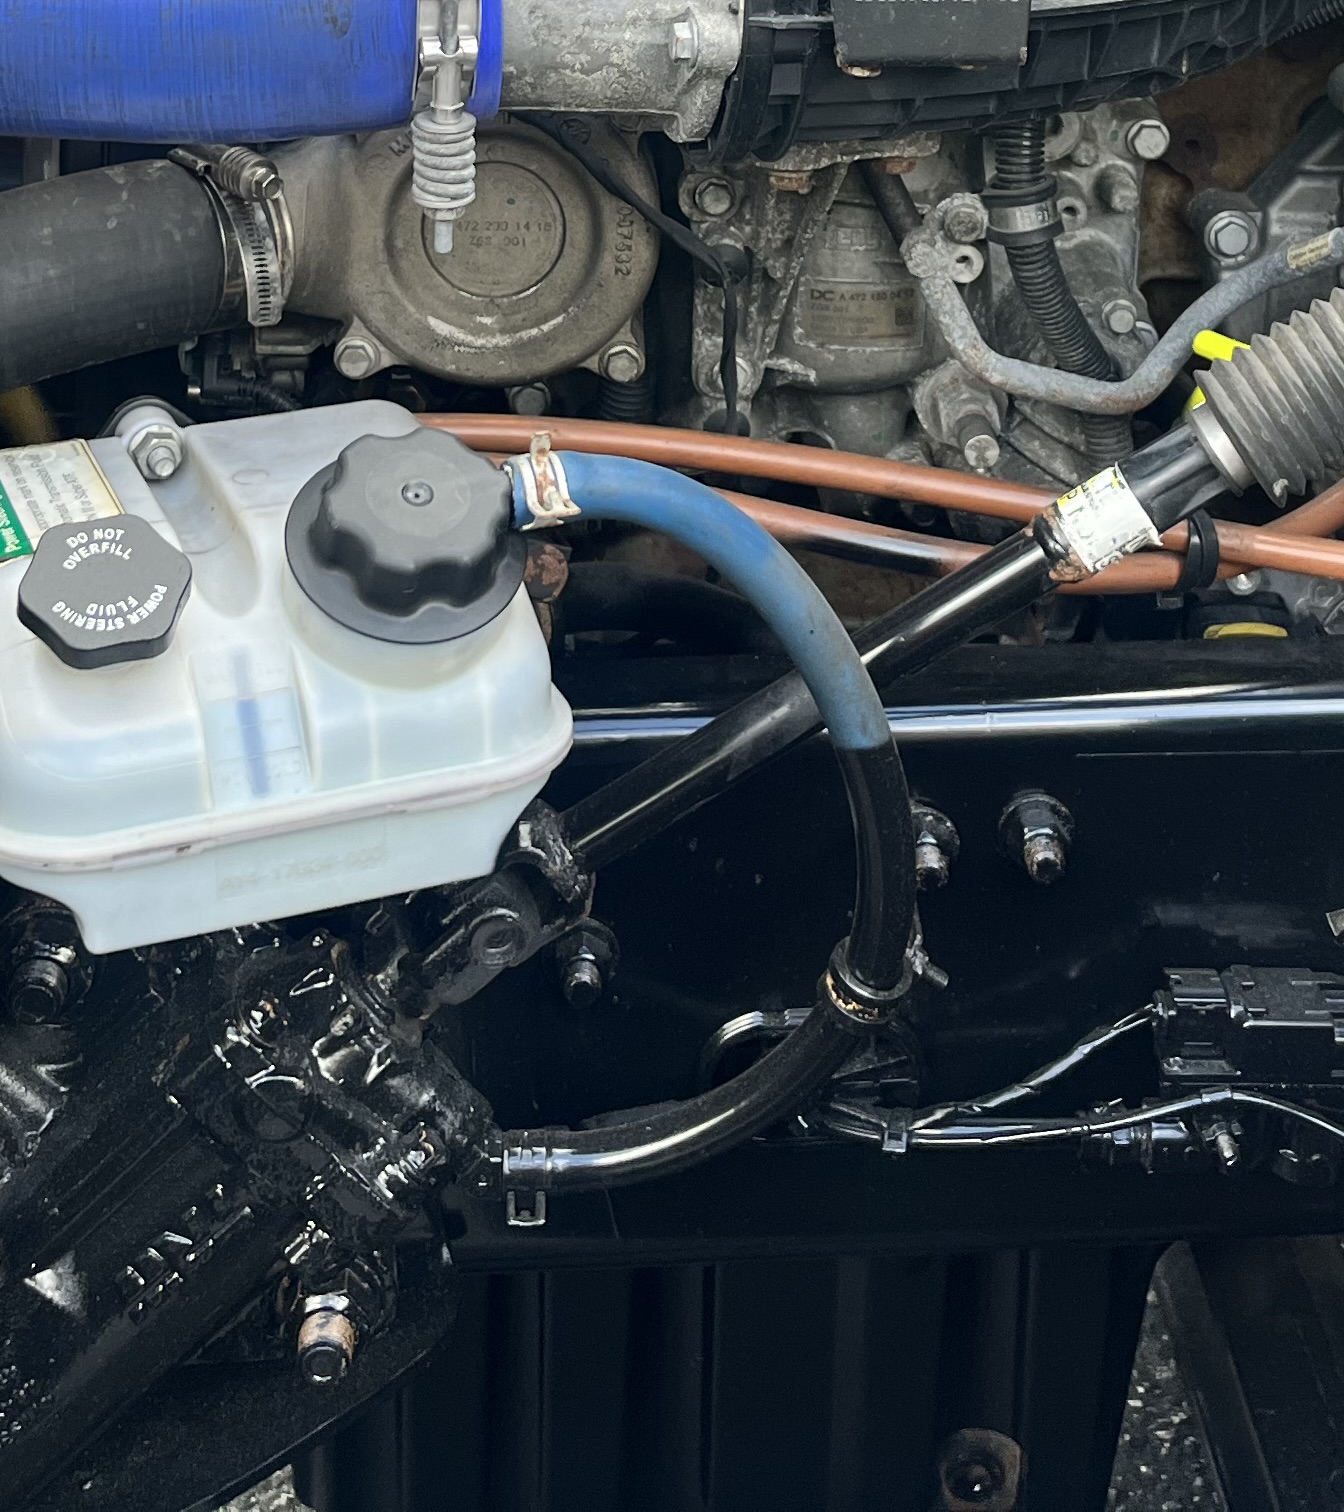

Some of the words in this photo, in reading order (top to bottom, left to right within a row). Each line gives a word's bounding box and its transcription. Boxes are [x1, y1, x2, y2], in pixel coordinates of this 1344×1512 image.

[810, 289, 835, 302] DC
[0, 526, 23, 553] Power
[66, 532, 89, 549] DO
[93, 528, 125, 541] NOT
[63, 541, 132, 570] OVERFILL
[52, 600, 125, 631] STEERING
[86, 595, 139, 617] FLUID
[127, 584, 168, 624] POWER
